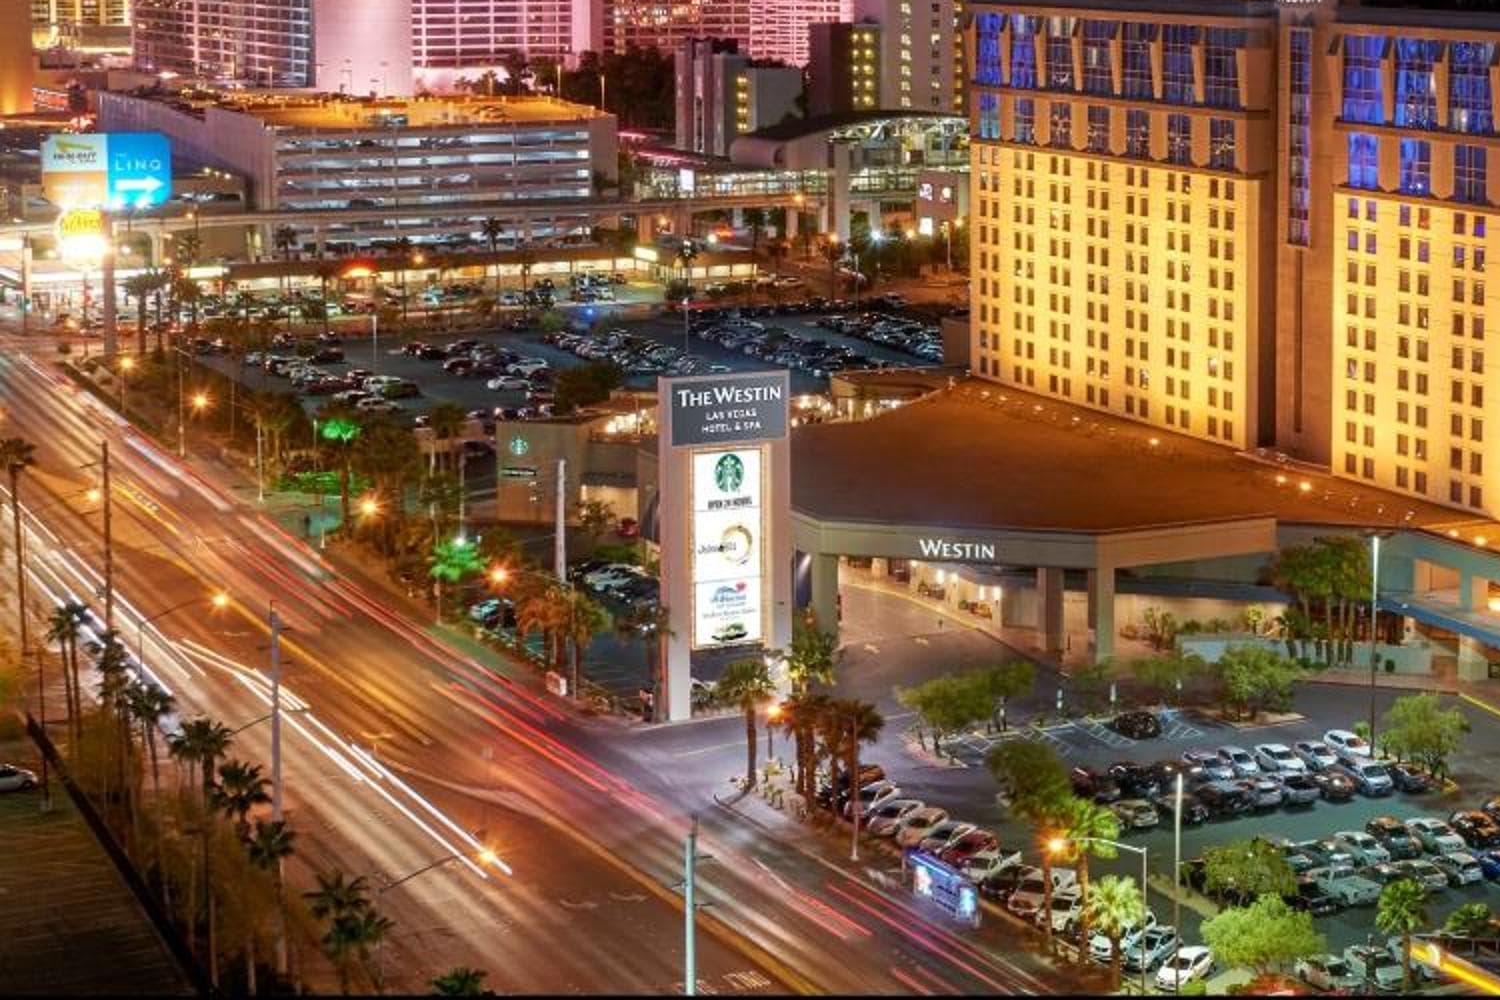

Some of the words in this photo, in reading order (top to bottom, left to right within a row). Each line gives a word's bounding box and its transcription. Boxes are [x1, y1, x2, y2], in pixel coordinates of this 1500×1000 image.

[677, 389, 712, 408] THE
[713, 386, 781, 405] WESTIN
[705, 410, 724, 420] LAS
[727, 407, 757, 419] VEGAS
[701, 423, 732, 433] HOTEL
[744, 421, 761, 430] SPA
[919, 538, 995, 559] WESTIN
